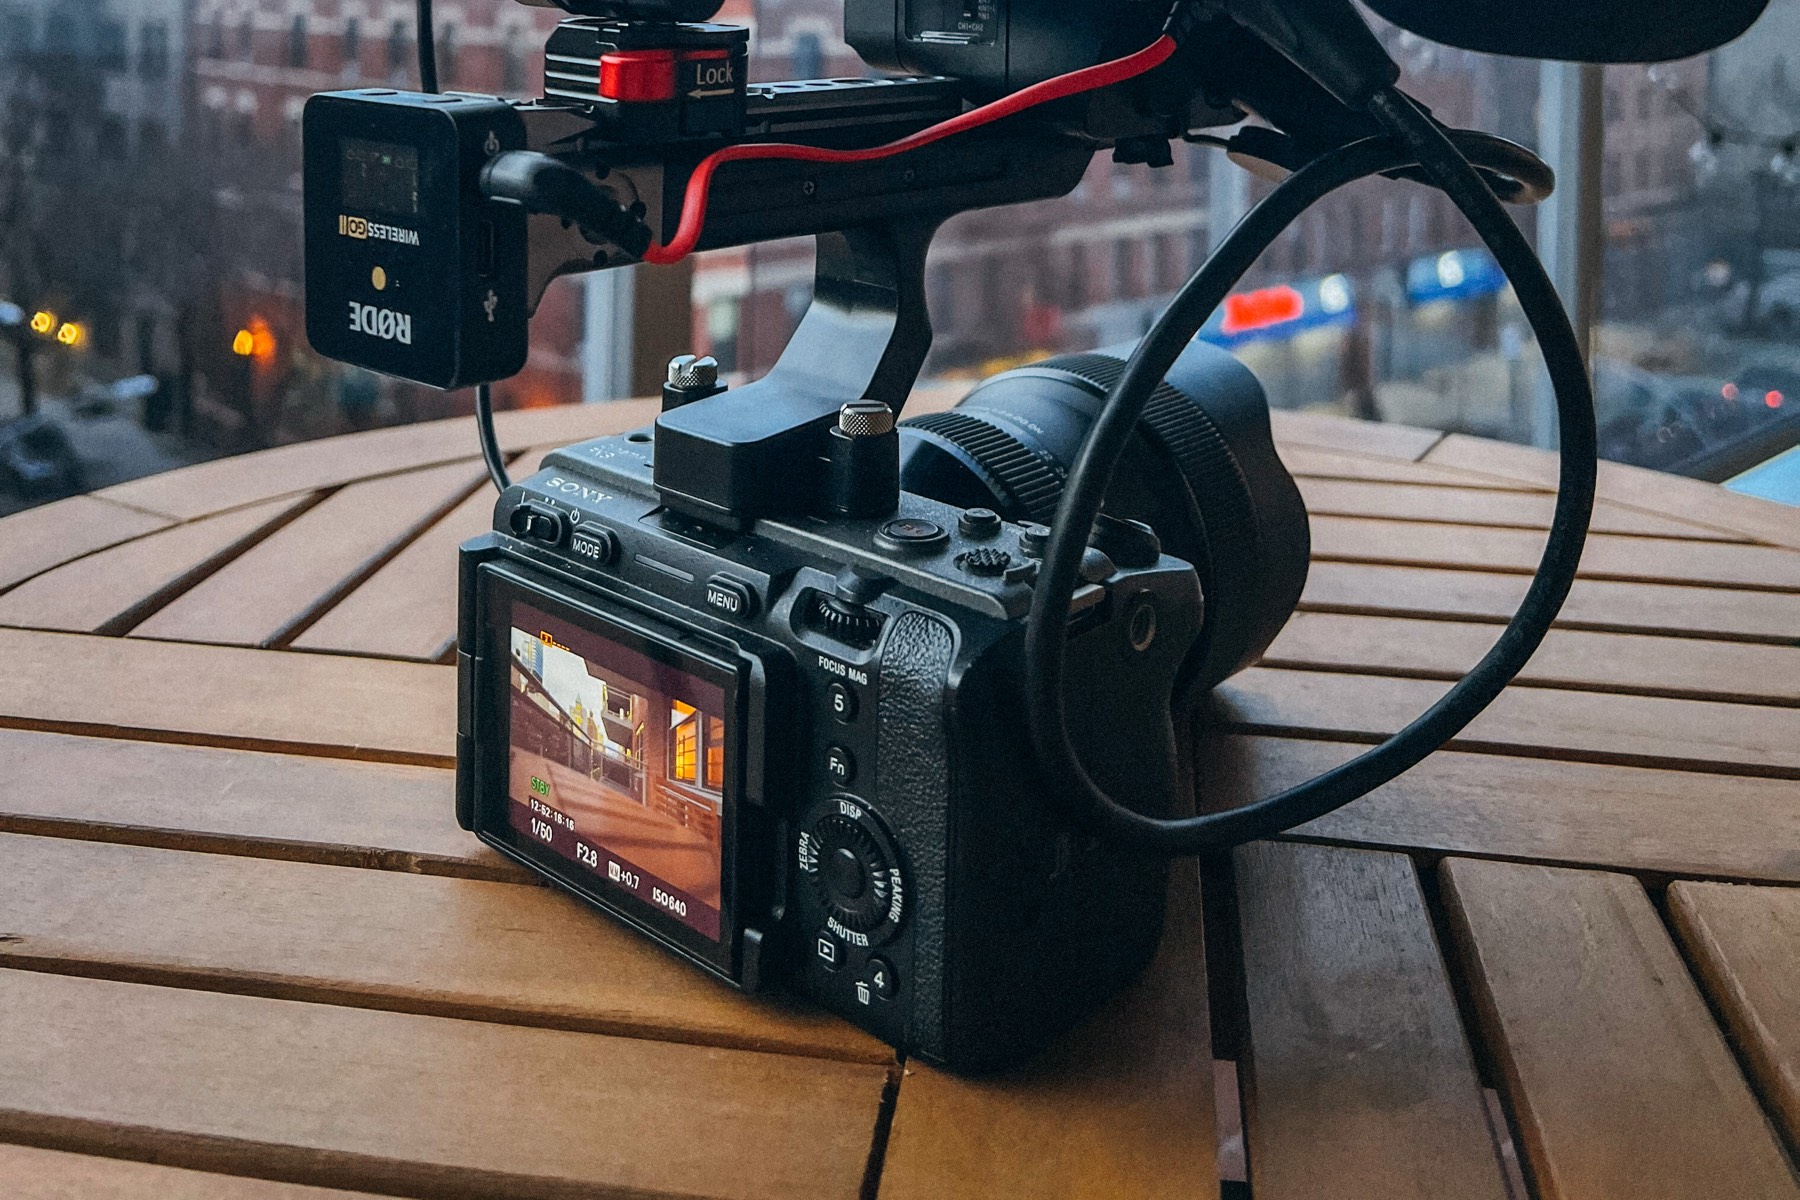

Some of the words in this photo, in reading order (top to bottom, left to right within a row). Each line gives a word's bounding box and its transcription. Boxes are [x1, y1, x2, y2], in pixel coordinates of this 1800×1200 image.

[696, 60, 734, 85] Lock
[368, 222, 420, 246] WIRELESS
[349, 300, 412, 345] RØDE
[546, 477, 613, 504] SONY
[572, 538, 600, 559] MODE
[707, 589, 738, 612] MENU
[818, 655, 846, 677] FOCUS
[848, 667, 868, 686] MAG
[834, 693, 844, 712] 5
[829, 757, 845, 776] Fn
[531, 776, 550, 797] STBY
[839, 801, 862, 820] DISP
[531, 817, 553, 842] 1/50
[799, 831, 810, 871] ZEBRA
[889, 868, 903, 923] PEAKING
[827, 916, 869, 947] SHUTTER
[873, 971, 884, 989] 4
